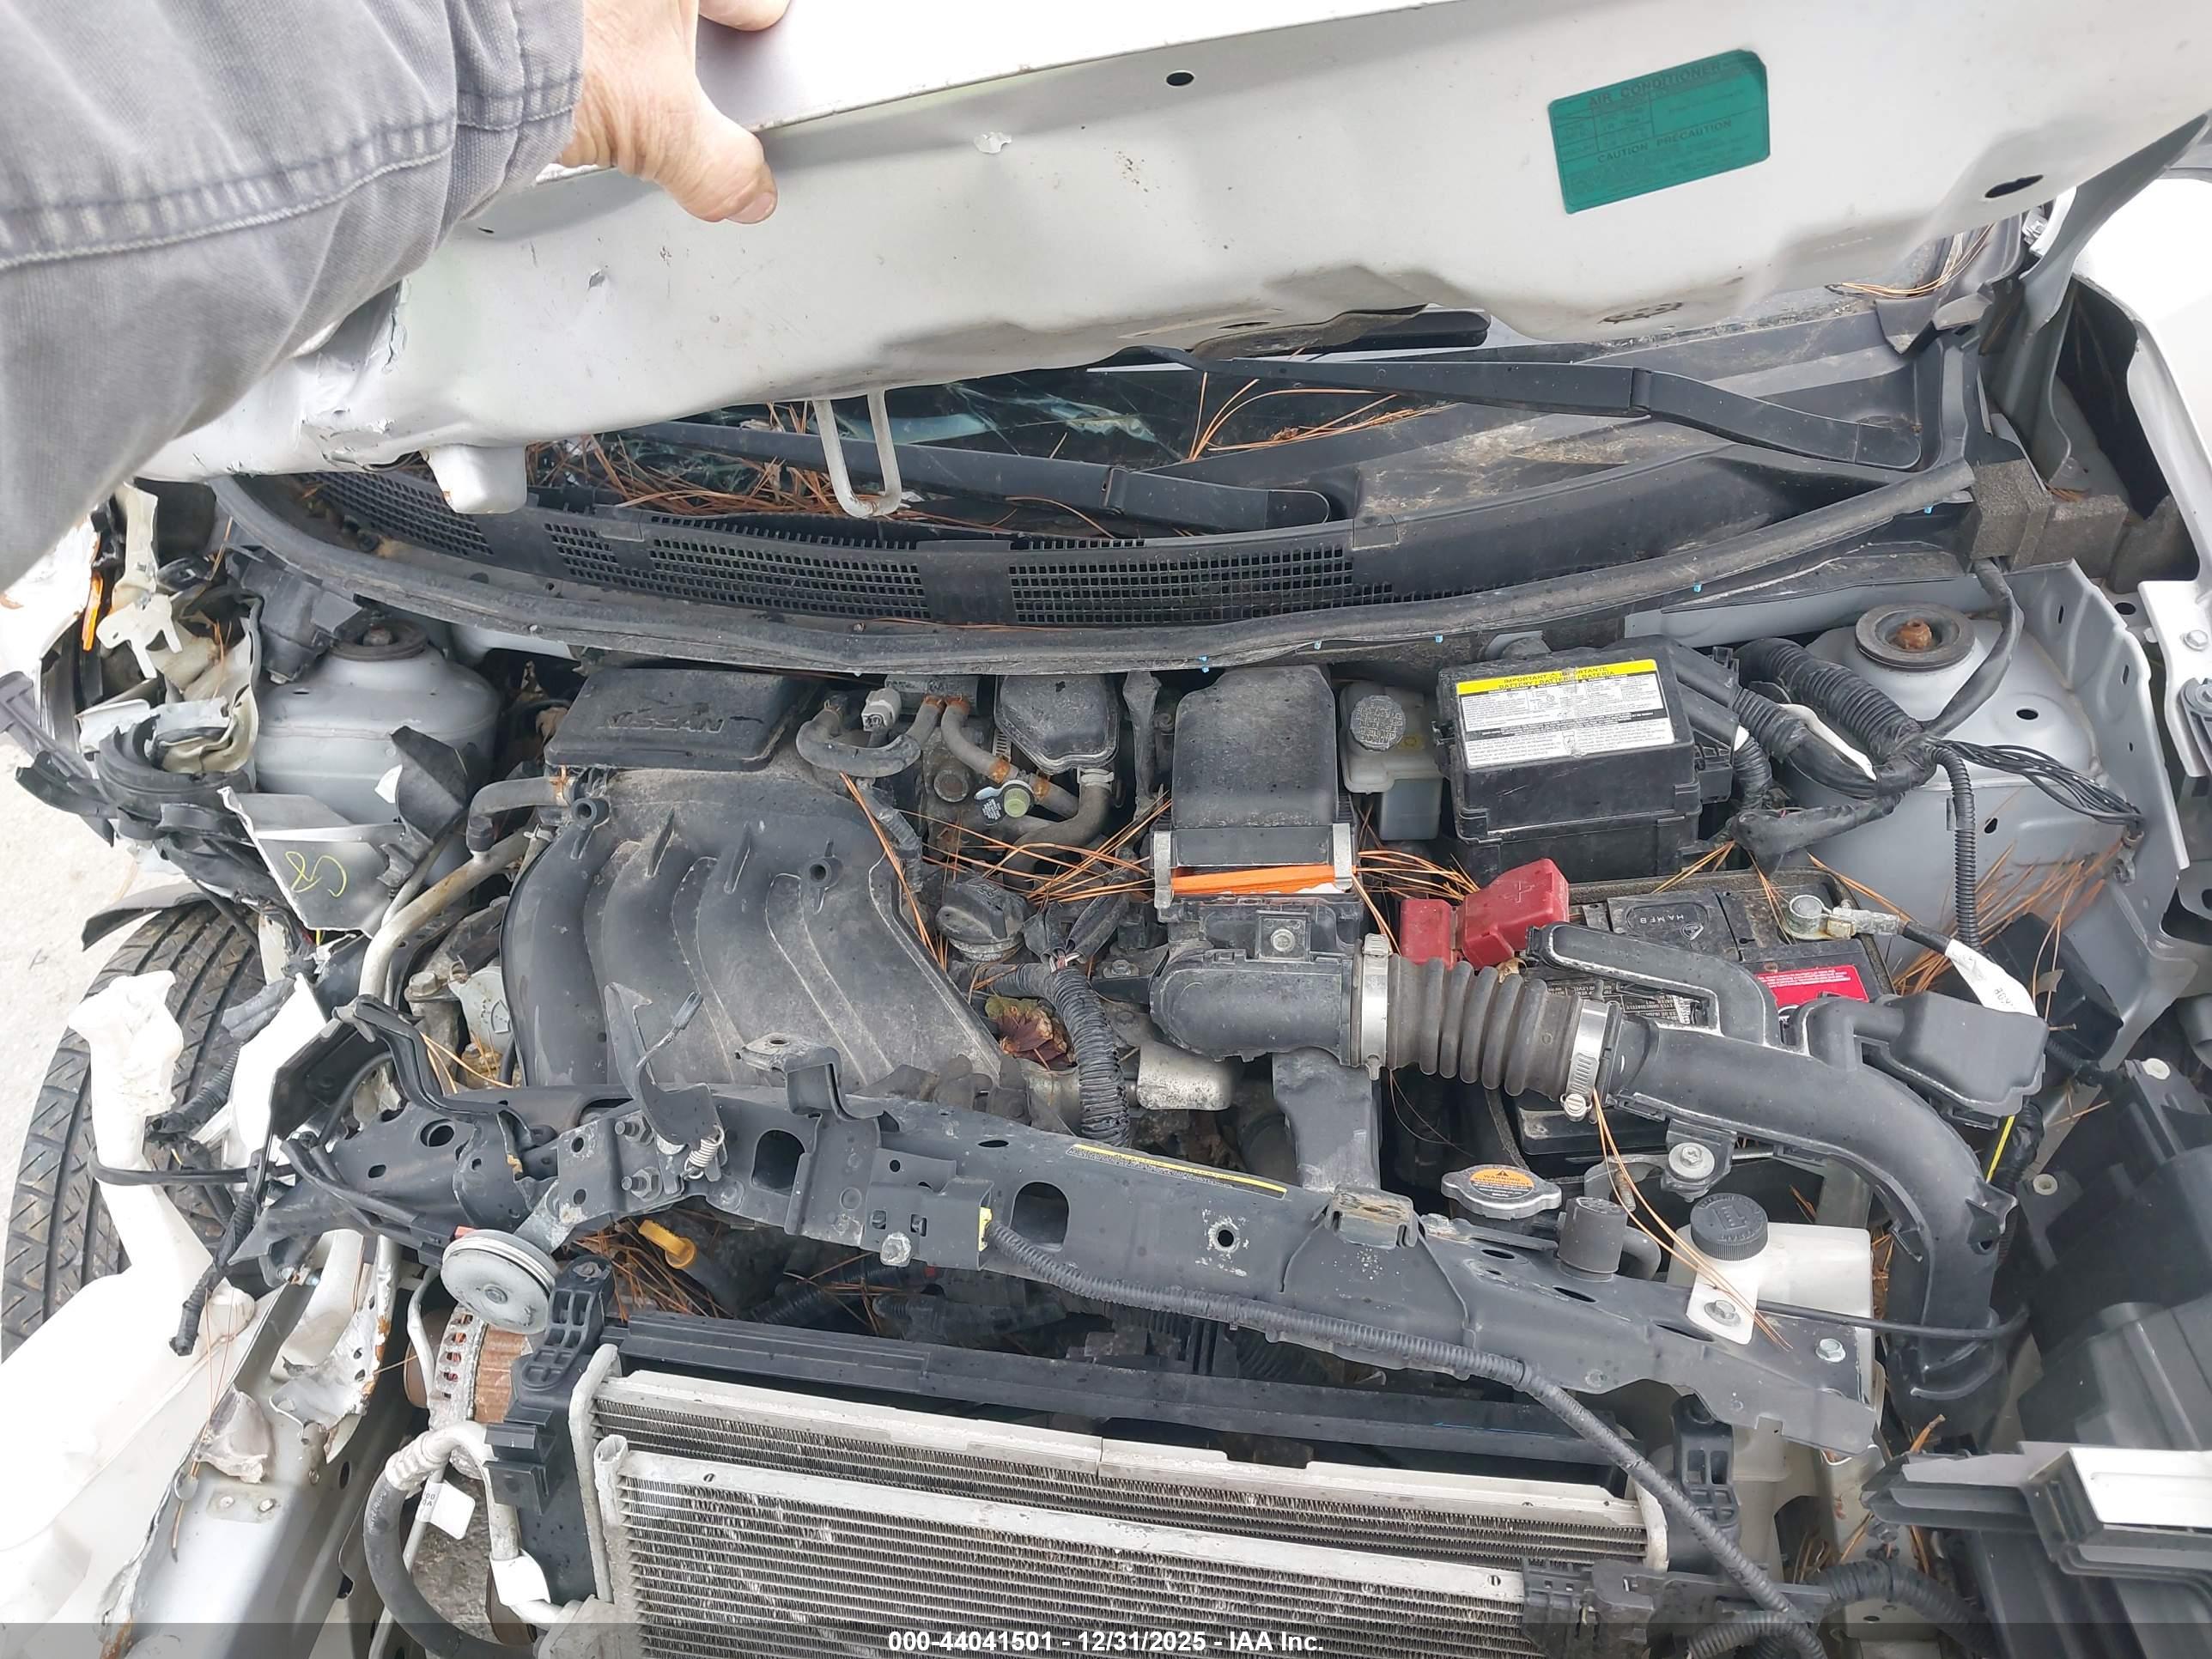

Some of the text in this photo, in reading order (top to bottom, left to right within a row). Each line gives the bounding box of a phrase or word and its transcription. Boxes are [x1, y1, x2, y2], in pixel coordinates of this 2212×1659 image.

[1589, 62, 1721, 106] AIR CONDITIONER
[1598, 142, 1649, 164] CAUTION
[1656, 119, 1732, 148] PRECAUTION
[601, 708, 726, 734] NISSAN
